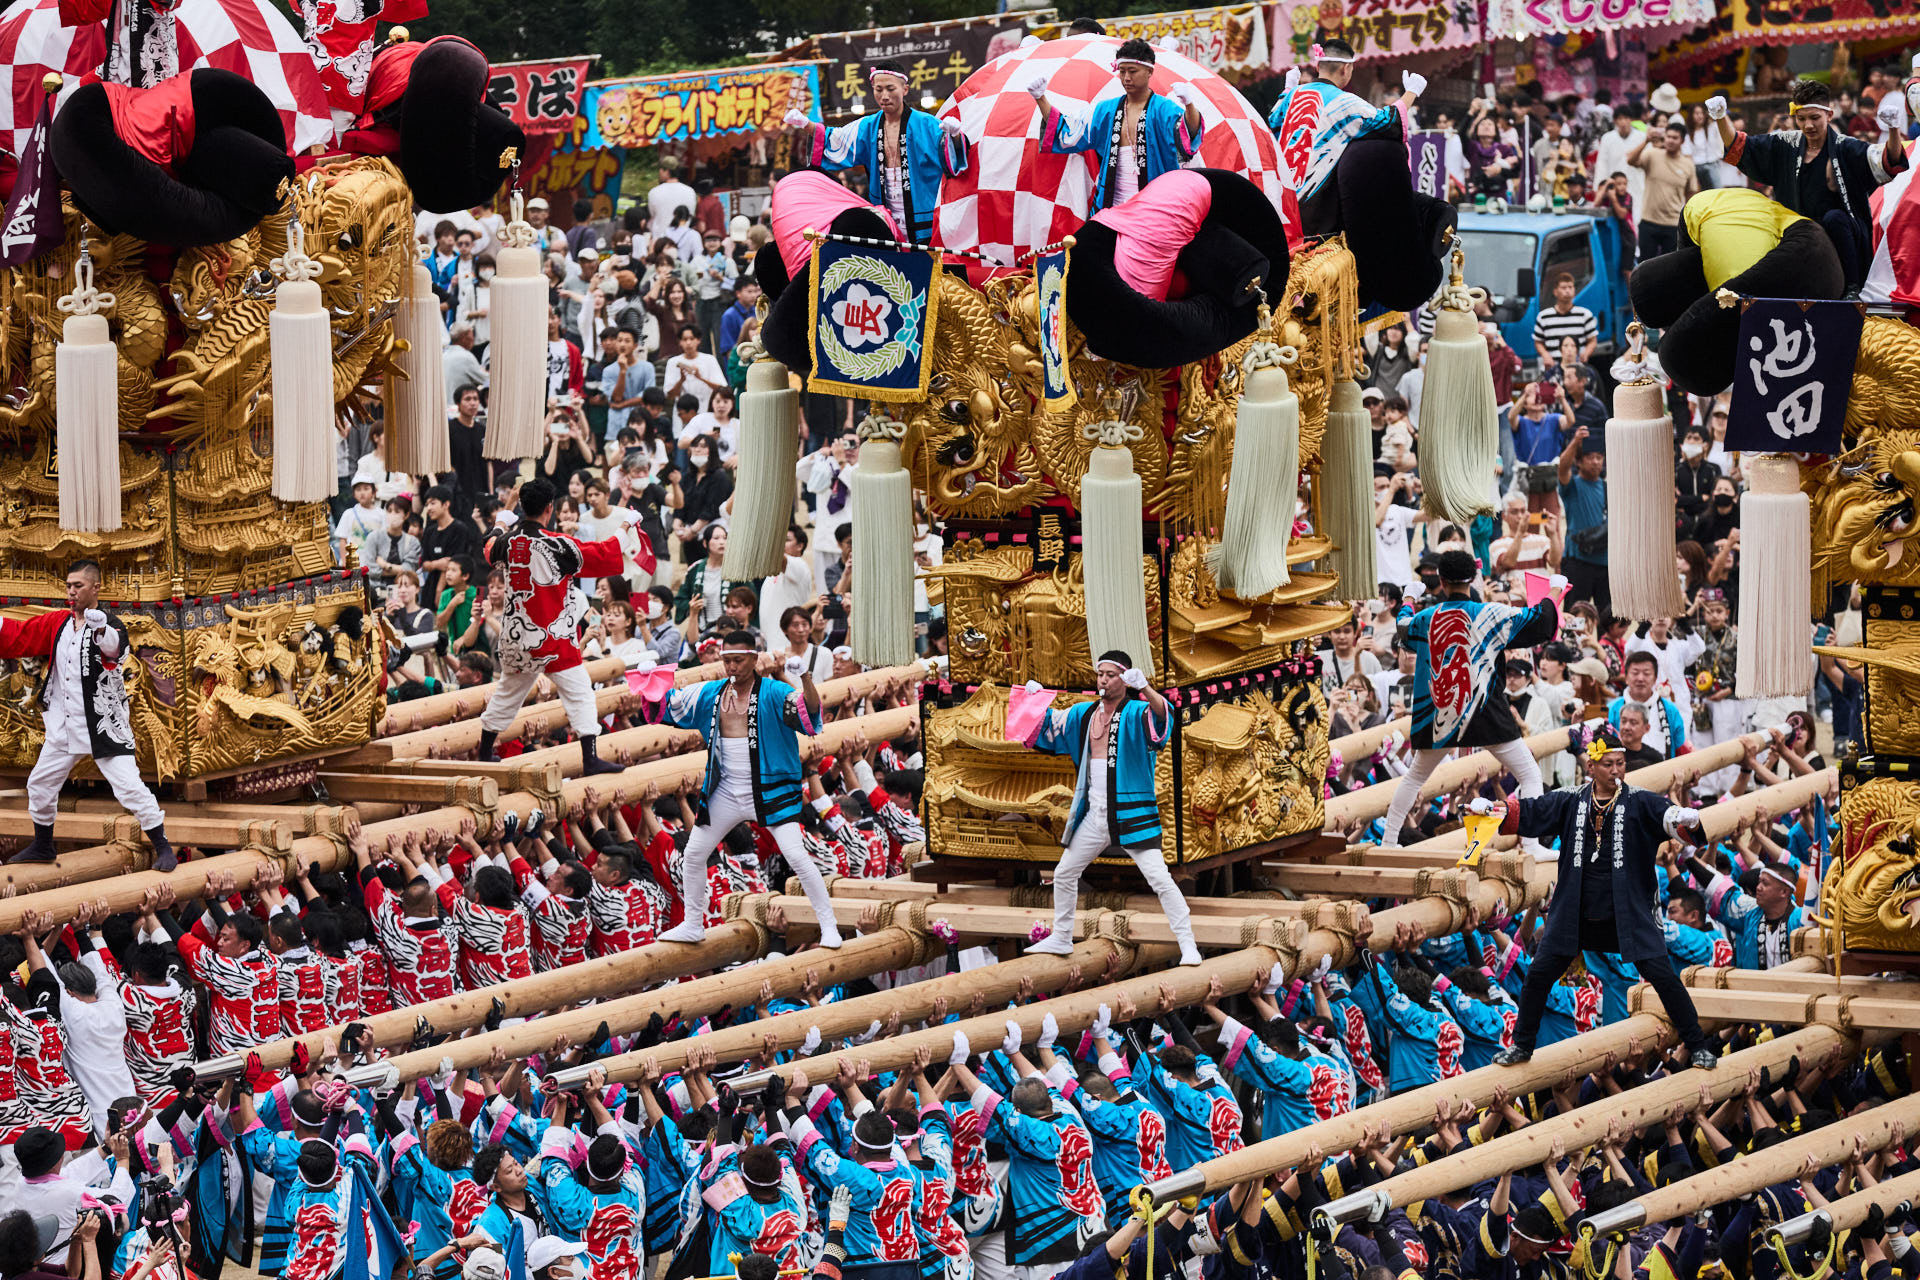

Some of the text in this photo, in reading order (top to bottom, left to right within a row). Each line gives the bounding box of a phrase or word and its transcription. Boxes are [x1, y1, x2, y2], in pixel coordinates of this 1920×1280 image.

[844, 299, 883, 337] 長
[1749, 318, 1825, 440] 池田
[1037, 513, 1065, 563] 長野
[748, 693, 758, 750] 長野太鼓台
[1107, 711, 1121, 768] 長野太鼓台
